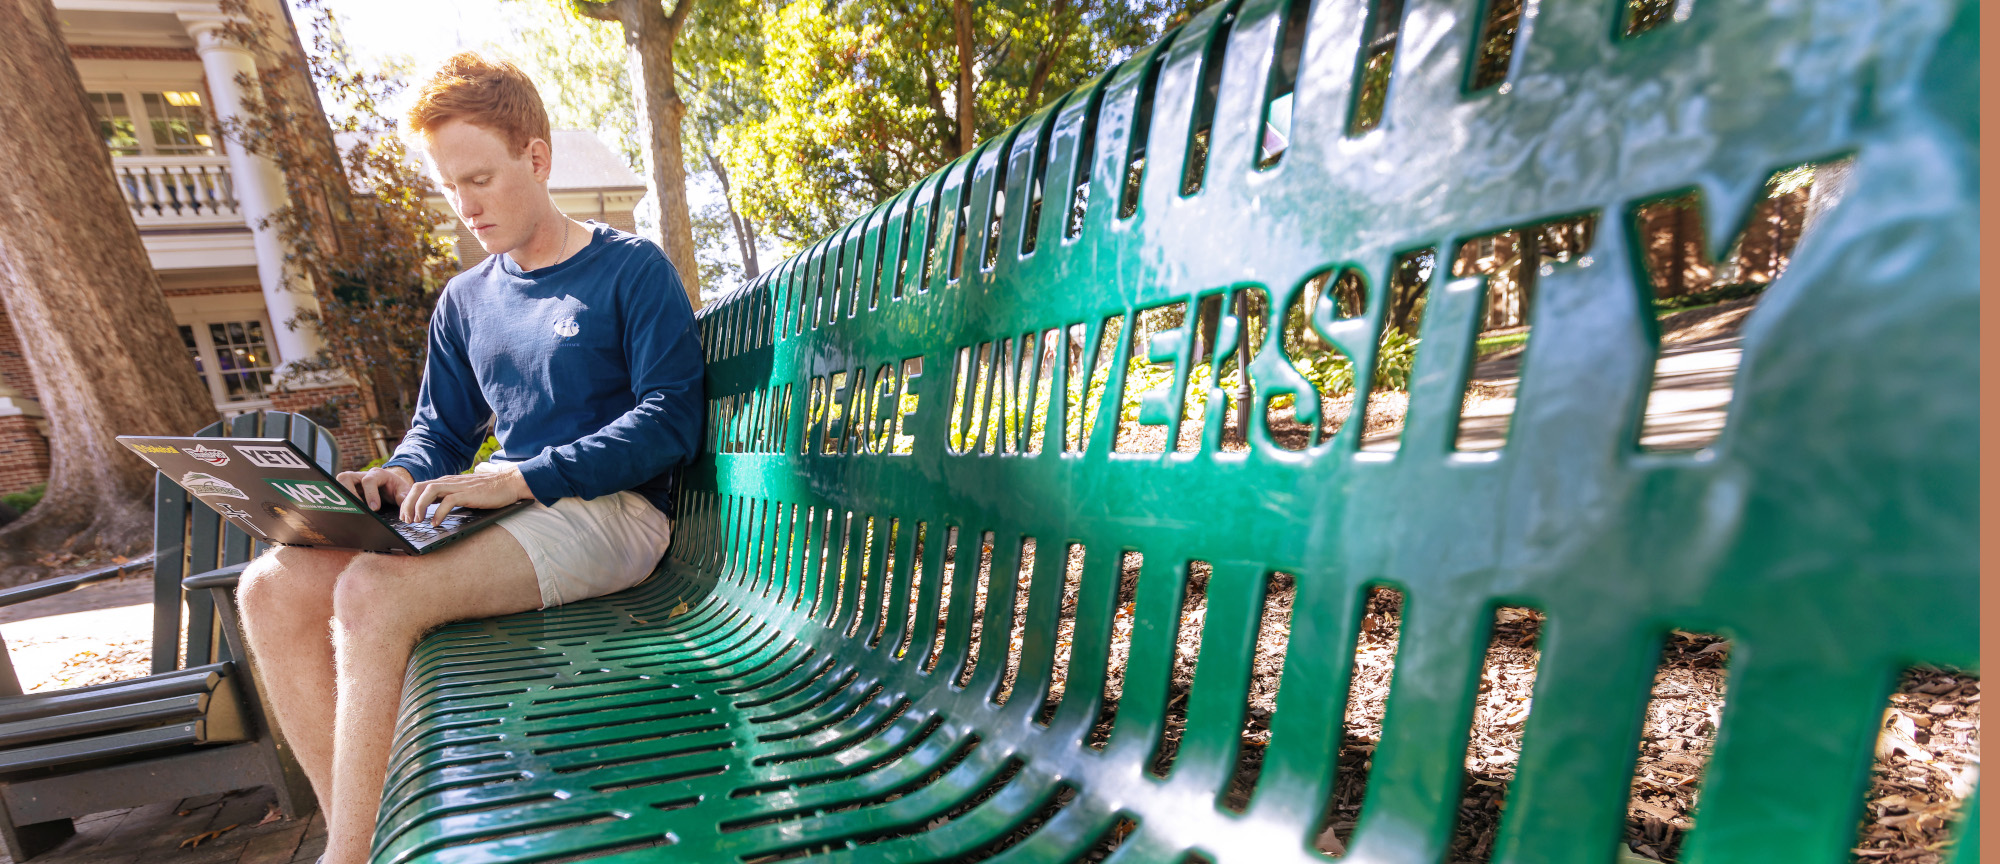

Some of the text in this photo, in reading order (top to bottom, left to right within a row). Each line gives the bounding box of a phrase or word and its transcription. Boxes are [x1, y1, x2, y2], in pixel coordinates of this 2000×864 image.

[801, 354, 924, 456] PEACE
[944, 150, 1860, 463] UNIVERSITY
[240, 449, 303, 466] YETI
[271, 482, 347, 505] WPU
